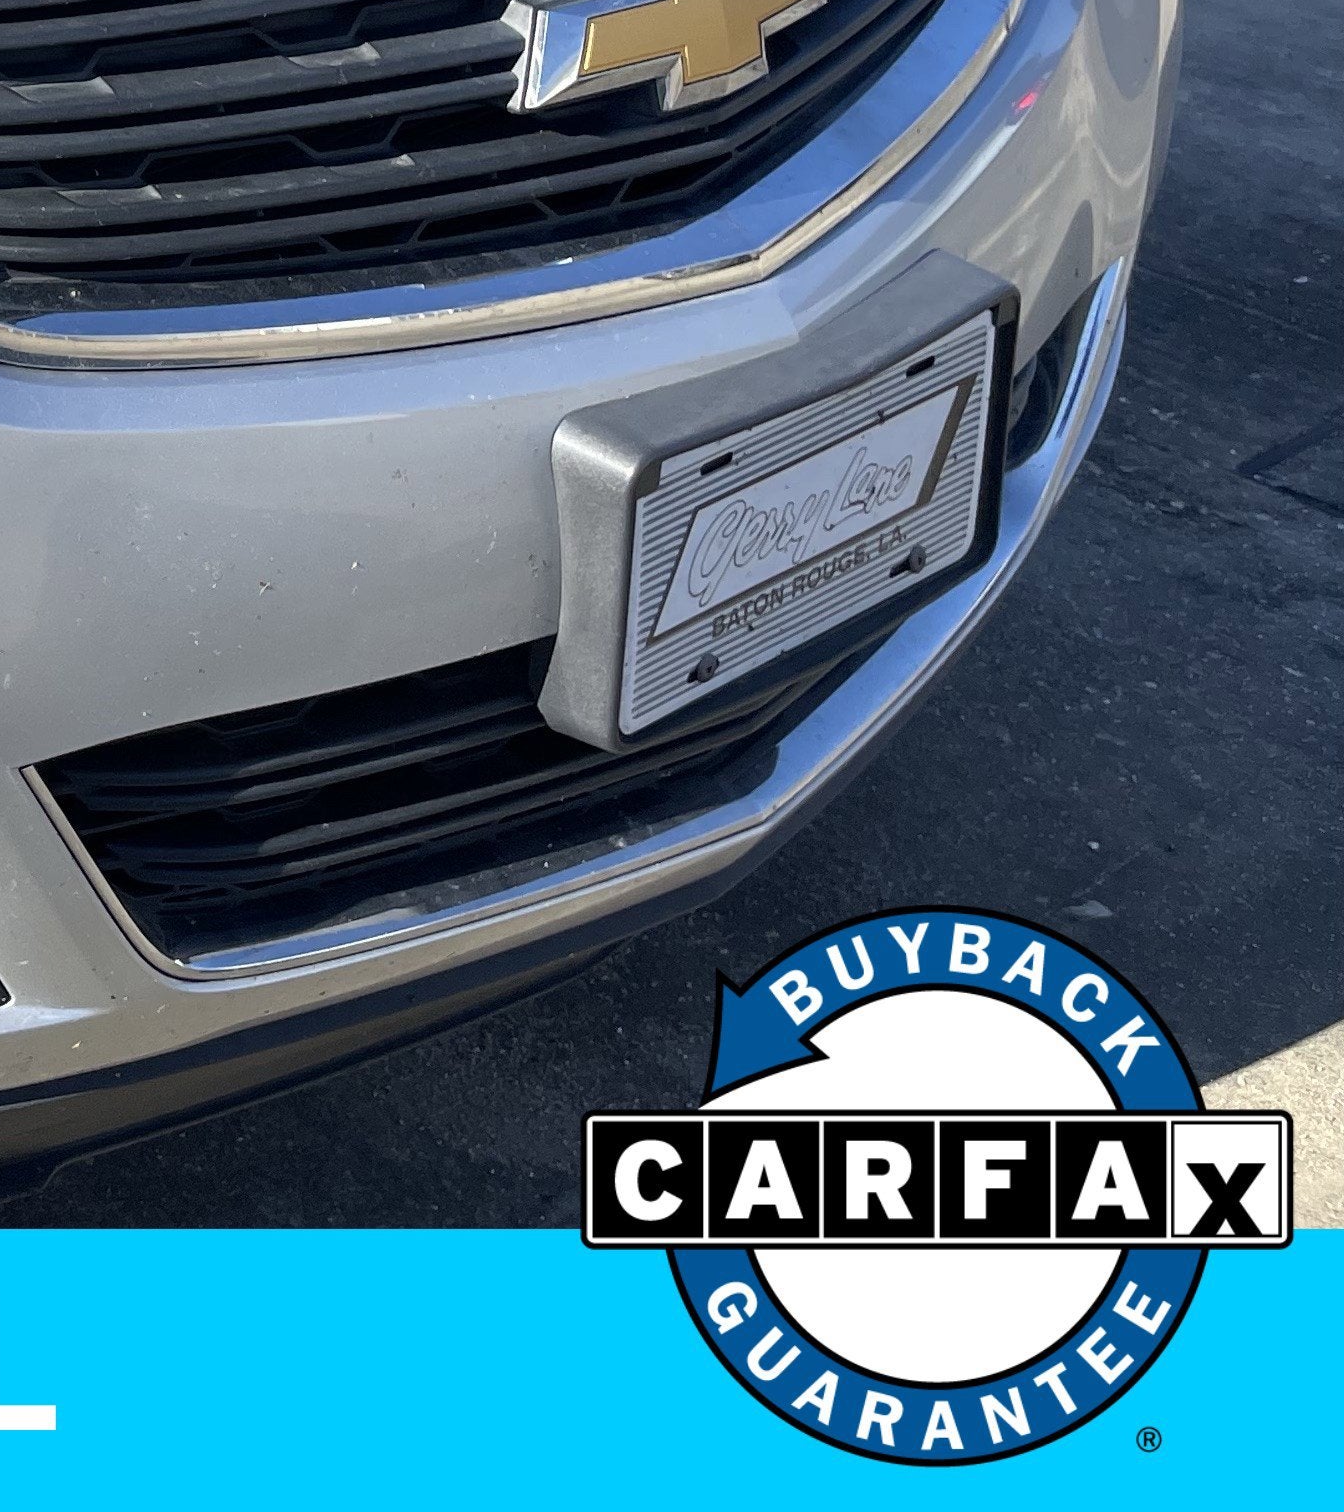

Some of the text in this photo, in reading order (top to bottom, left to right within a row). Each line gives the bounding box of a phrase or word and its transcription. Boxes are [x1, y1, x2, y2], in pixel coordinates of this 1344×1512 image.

[687, 445, 913, 608] Gerry Lane
[711, 584, 785, 638] BATON
[877, 524, 908, 555] LA.
